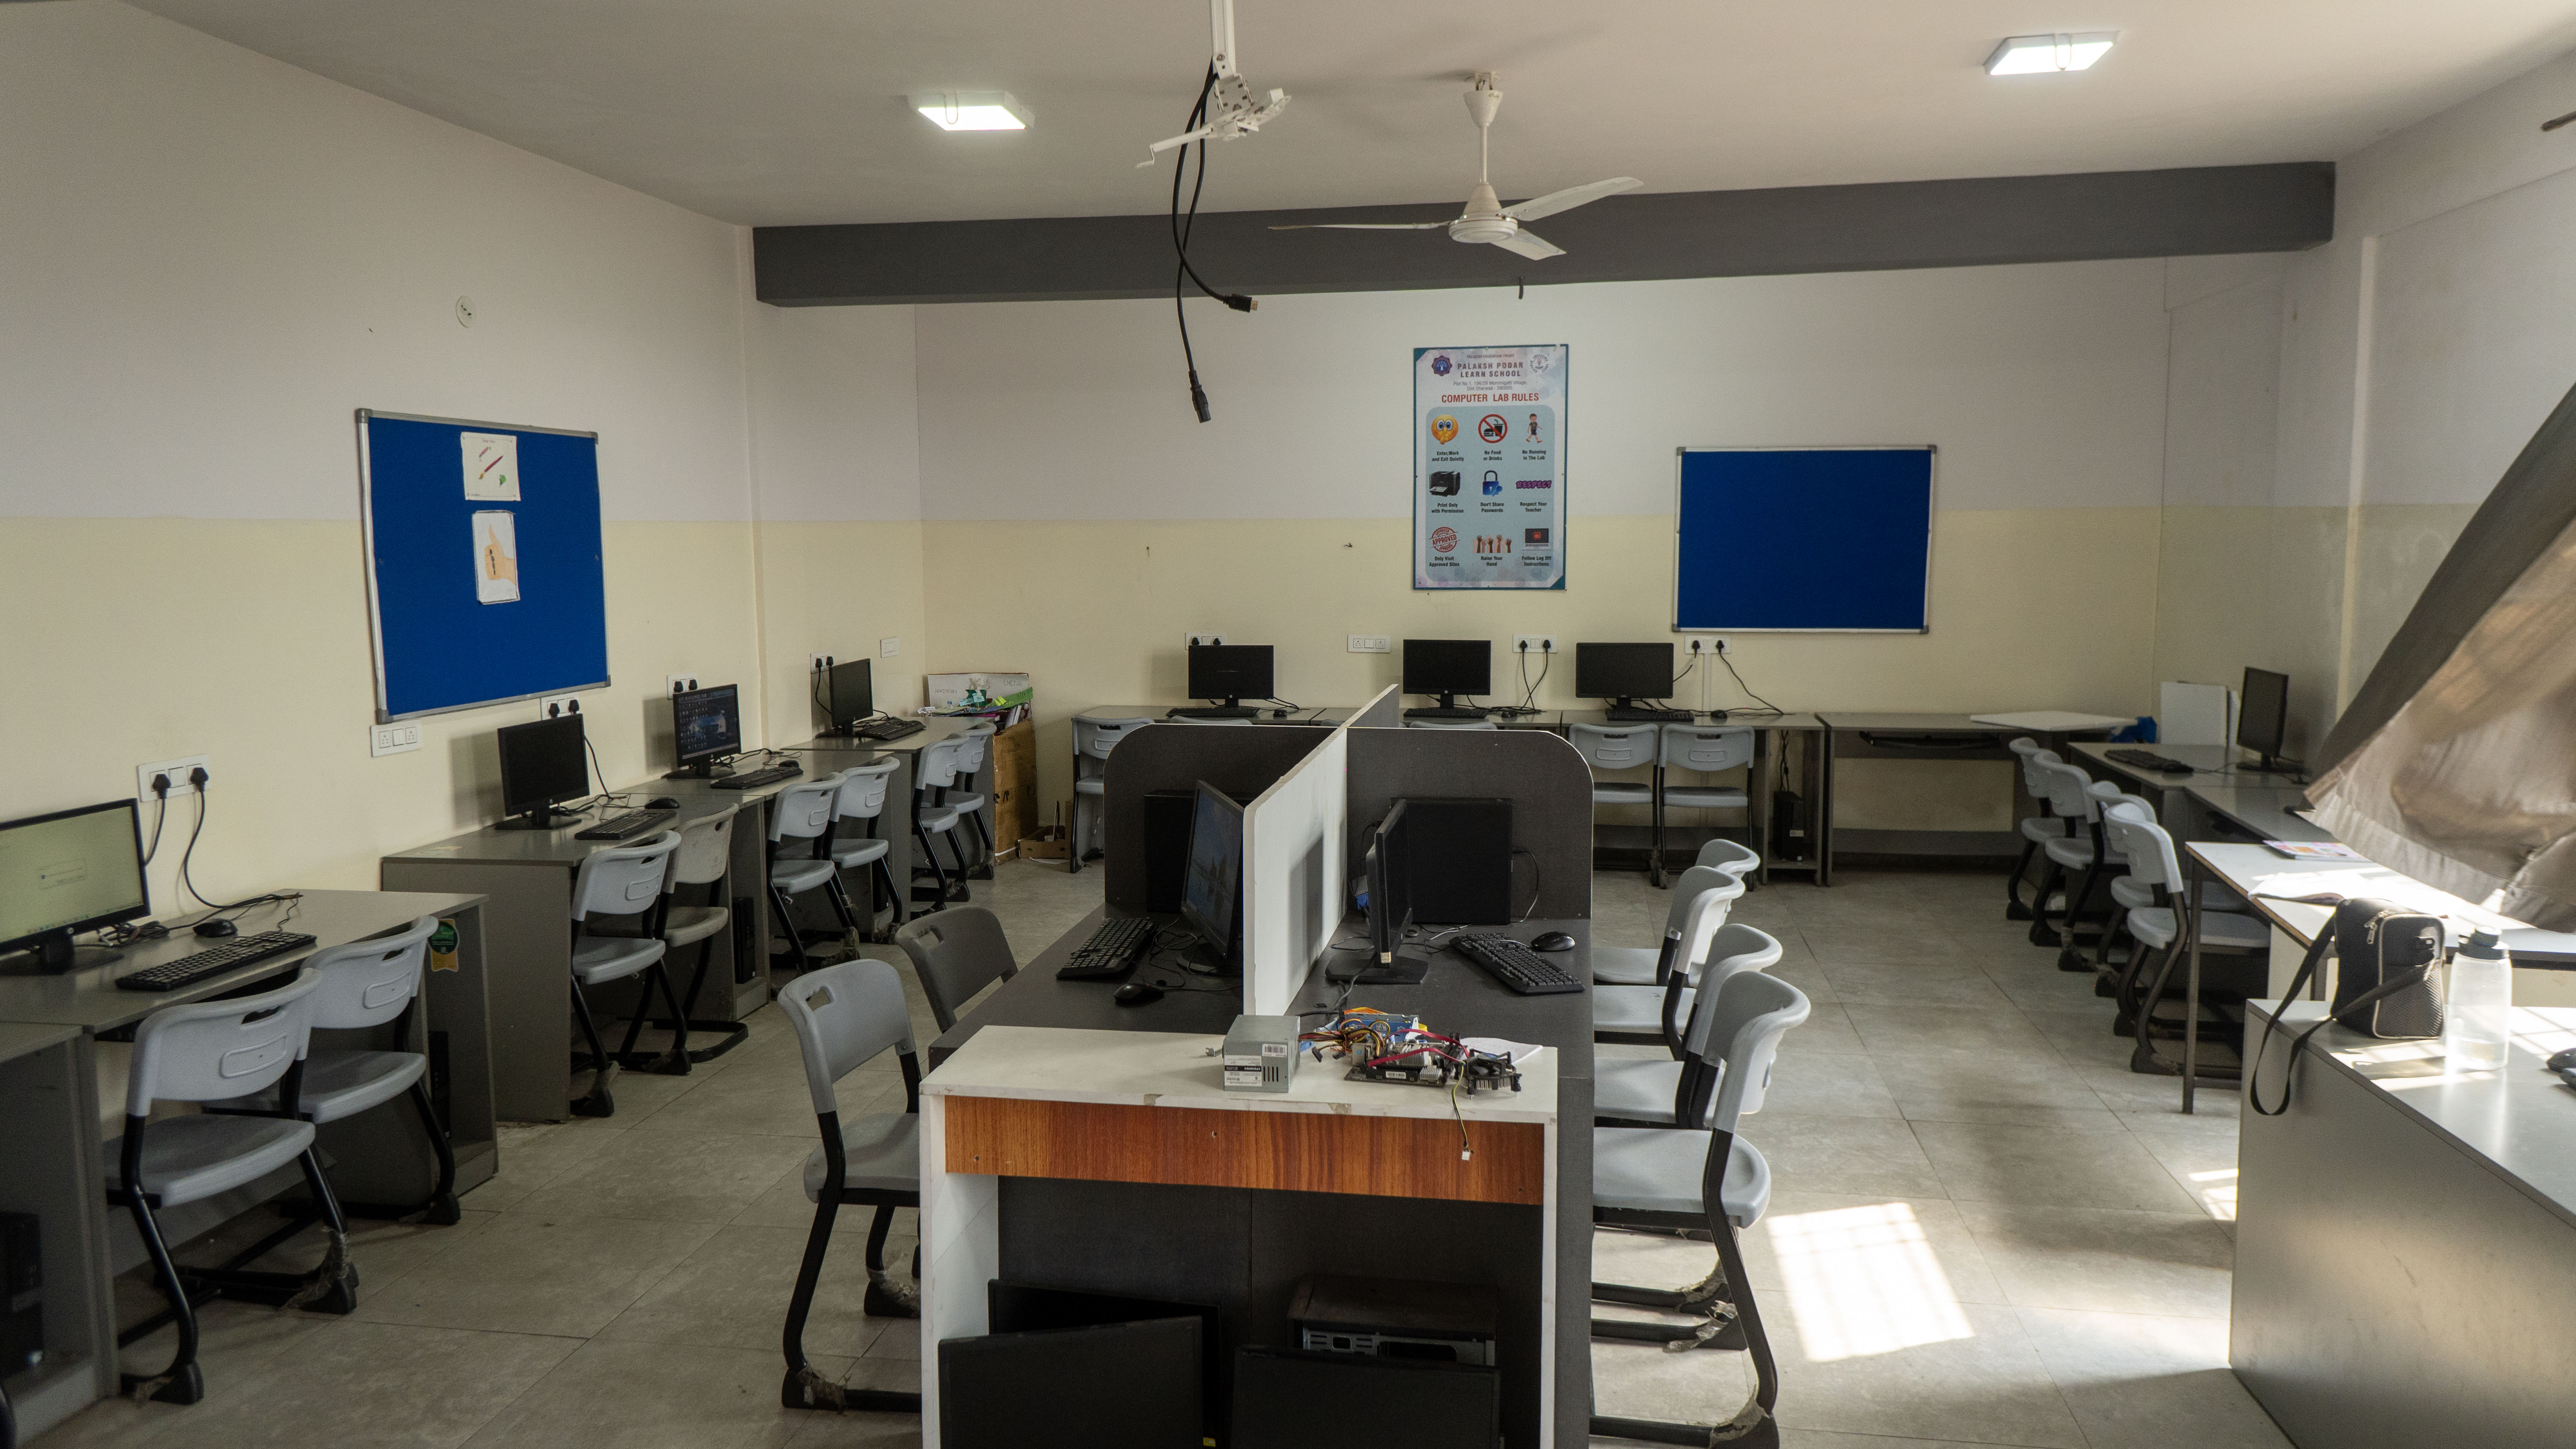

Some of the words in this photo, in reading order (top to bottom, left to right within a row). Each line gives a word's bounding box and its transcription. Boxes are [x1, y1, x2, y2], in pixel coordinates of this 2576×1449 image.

[1442, 394, 1488, 403] COMPUTER
[1493, 394, 1509, 402] LAB
[1512, 393, 1539, 401] RULES
[1516, 480, 1552, 489] RESPECT
[1432, 534, 1457, 546] APPROVED
